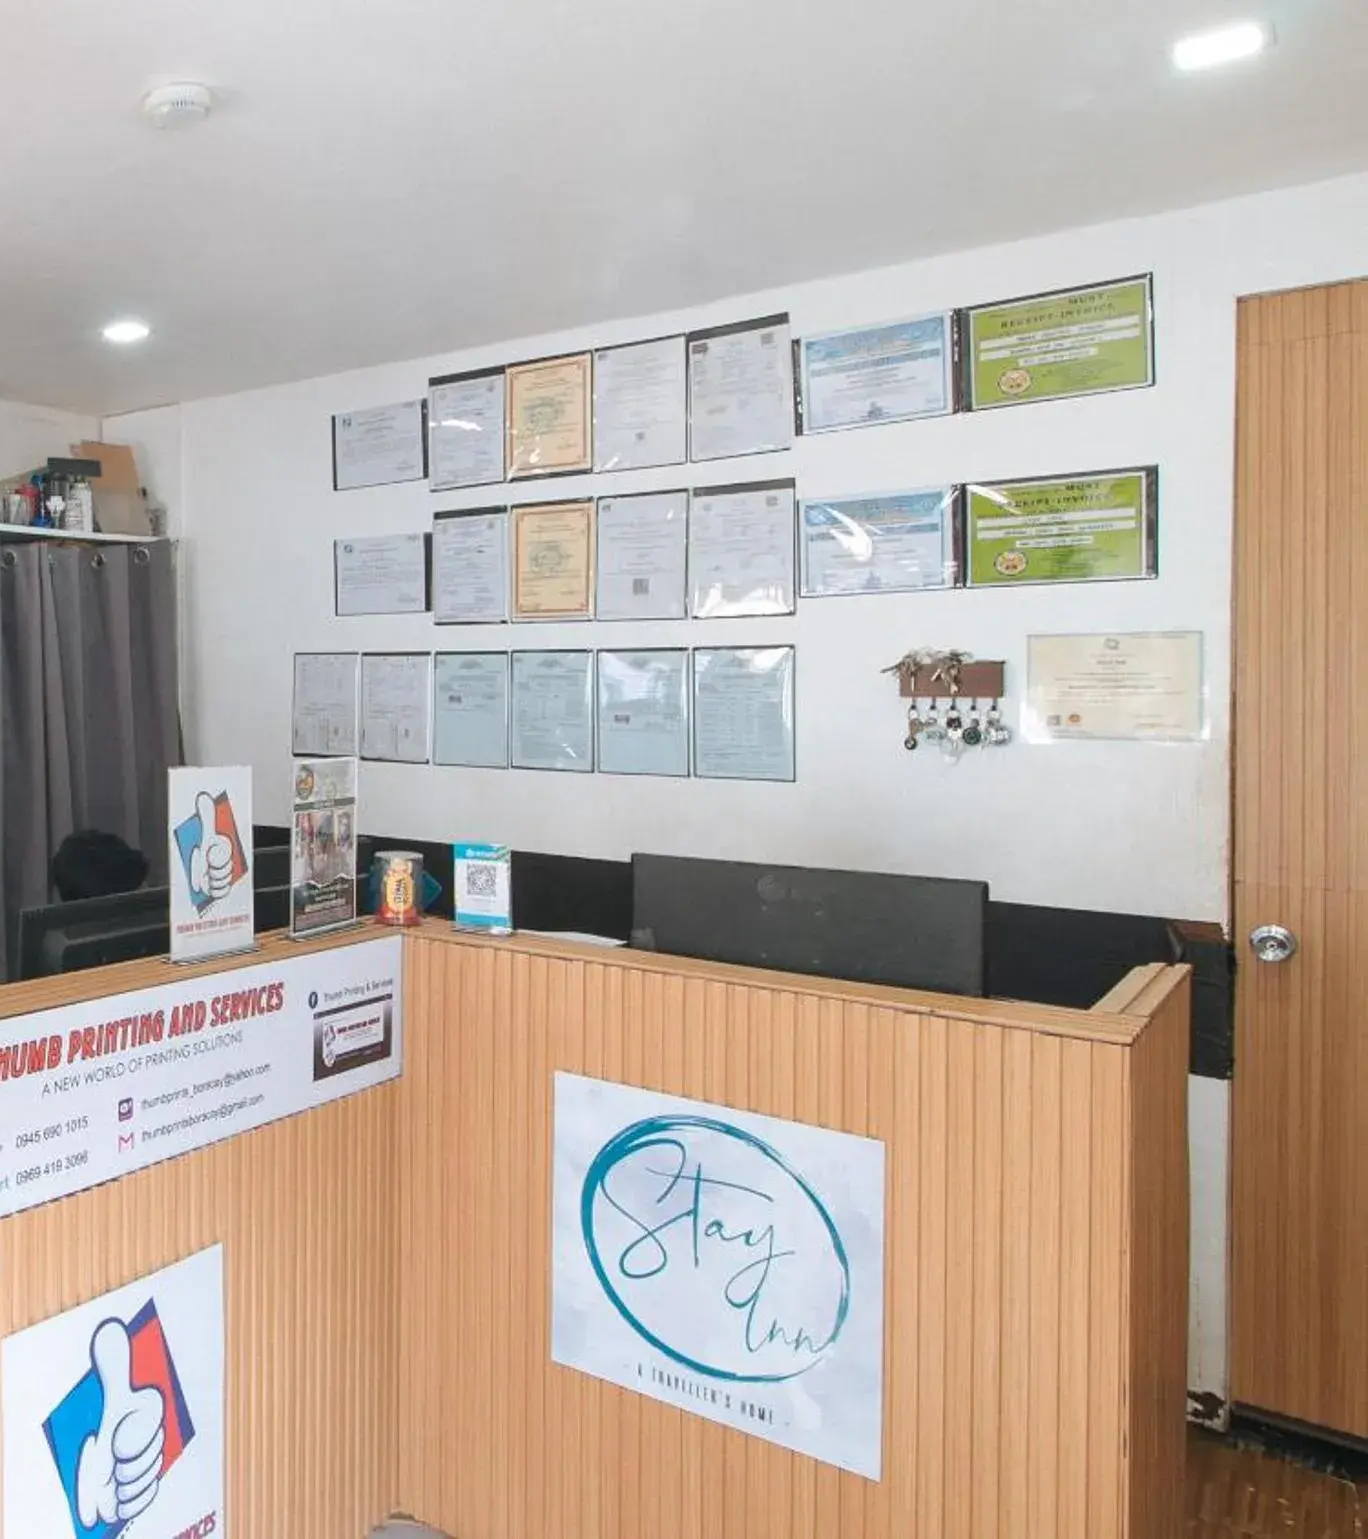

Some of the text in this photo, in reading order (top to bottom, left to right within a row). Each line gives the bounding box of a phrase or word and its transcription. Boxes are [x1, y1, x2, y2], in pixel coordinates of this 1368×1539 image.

[66, 1009, 165, 1065] PRINTING
[167, 1000, 207, 1039] AND
[209, 981, 285, 1028] SERVICES
[41, 1029, 244, 1098] A NEW WORLD OF PRINTING SOLUTIONS
[15, 1130, 42, 1149] 0945
[599, 1138, 794, 1309] Stay
[744, 1292, 831, 1355] Inn
[740, 1400, 774, 1425] HOME
